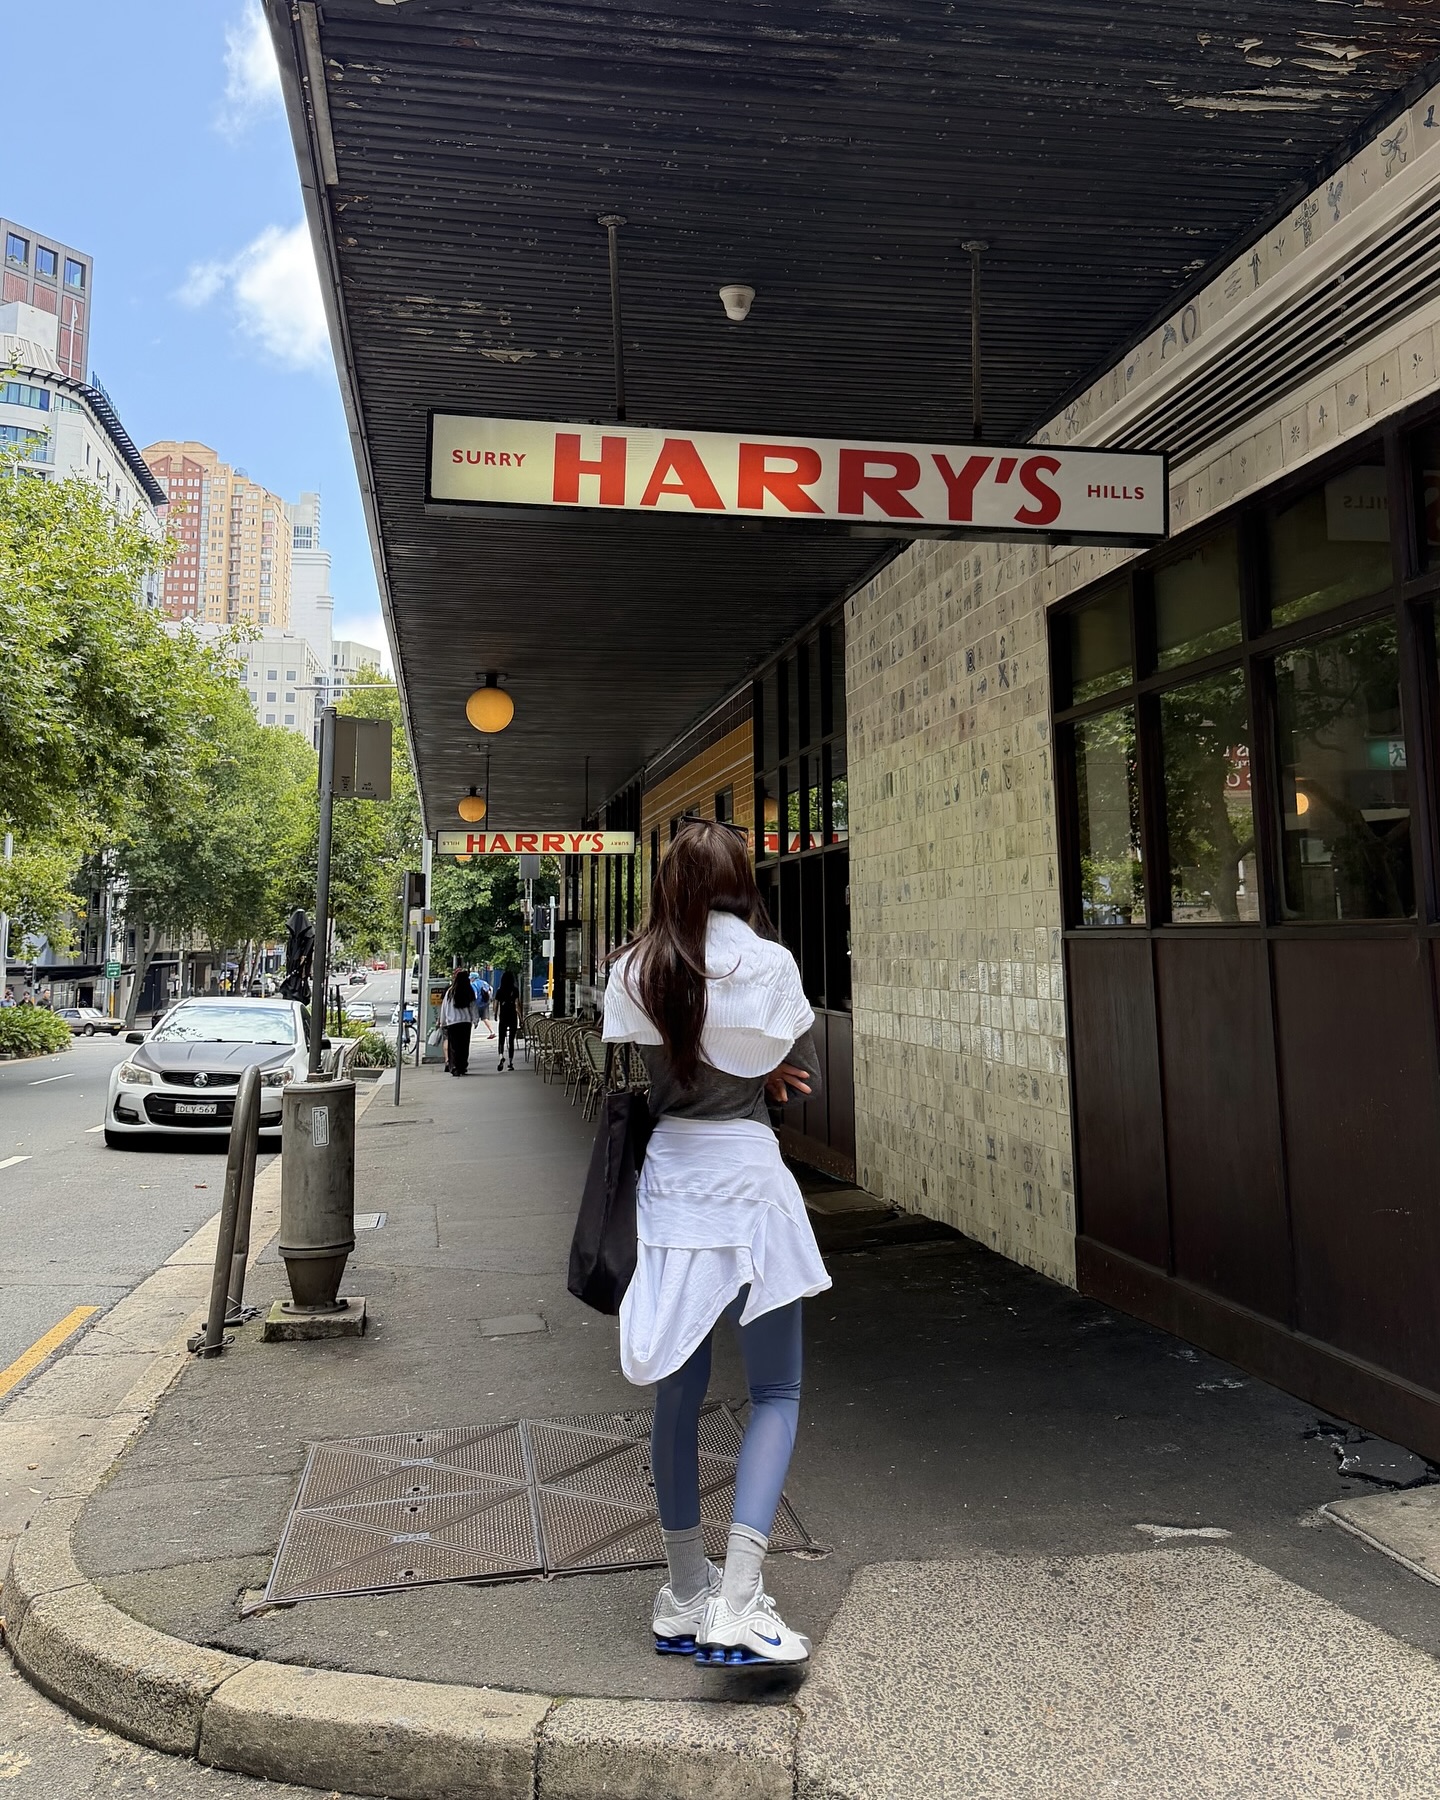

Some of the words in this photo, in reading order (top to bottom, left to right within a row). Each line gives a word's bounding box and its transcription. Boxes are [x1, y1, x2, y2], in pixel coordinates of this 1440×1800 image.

[452, 449, 527, 467] SURRY
[553, 432, 1062, 526] HARRY'S
[1087, 484, 1145, 500] HILLS
[466, 833, 604, 853] HARRY'S
